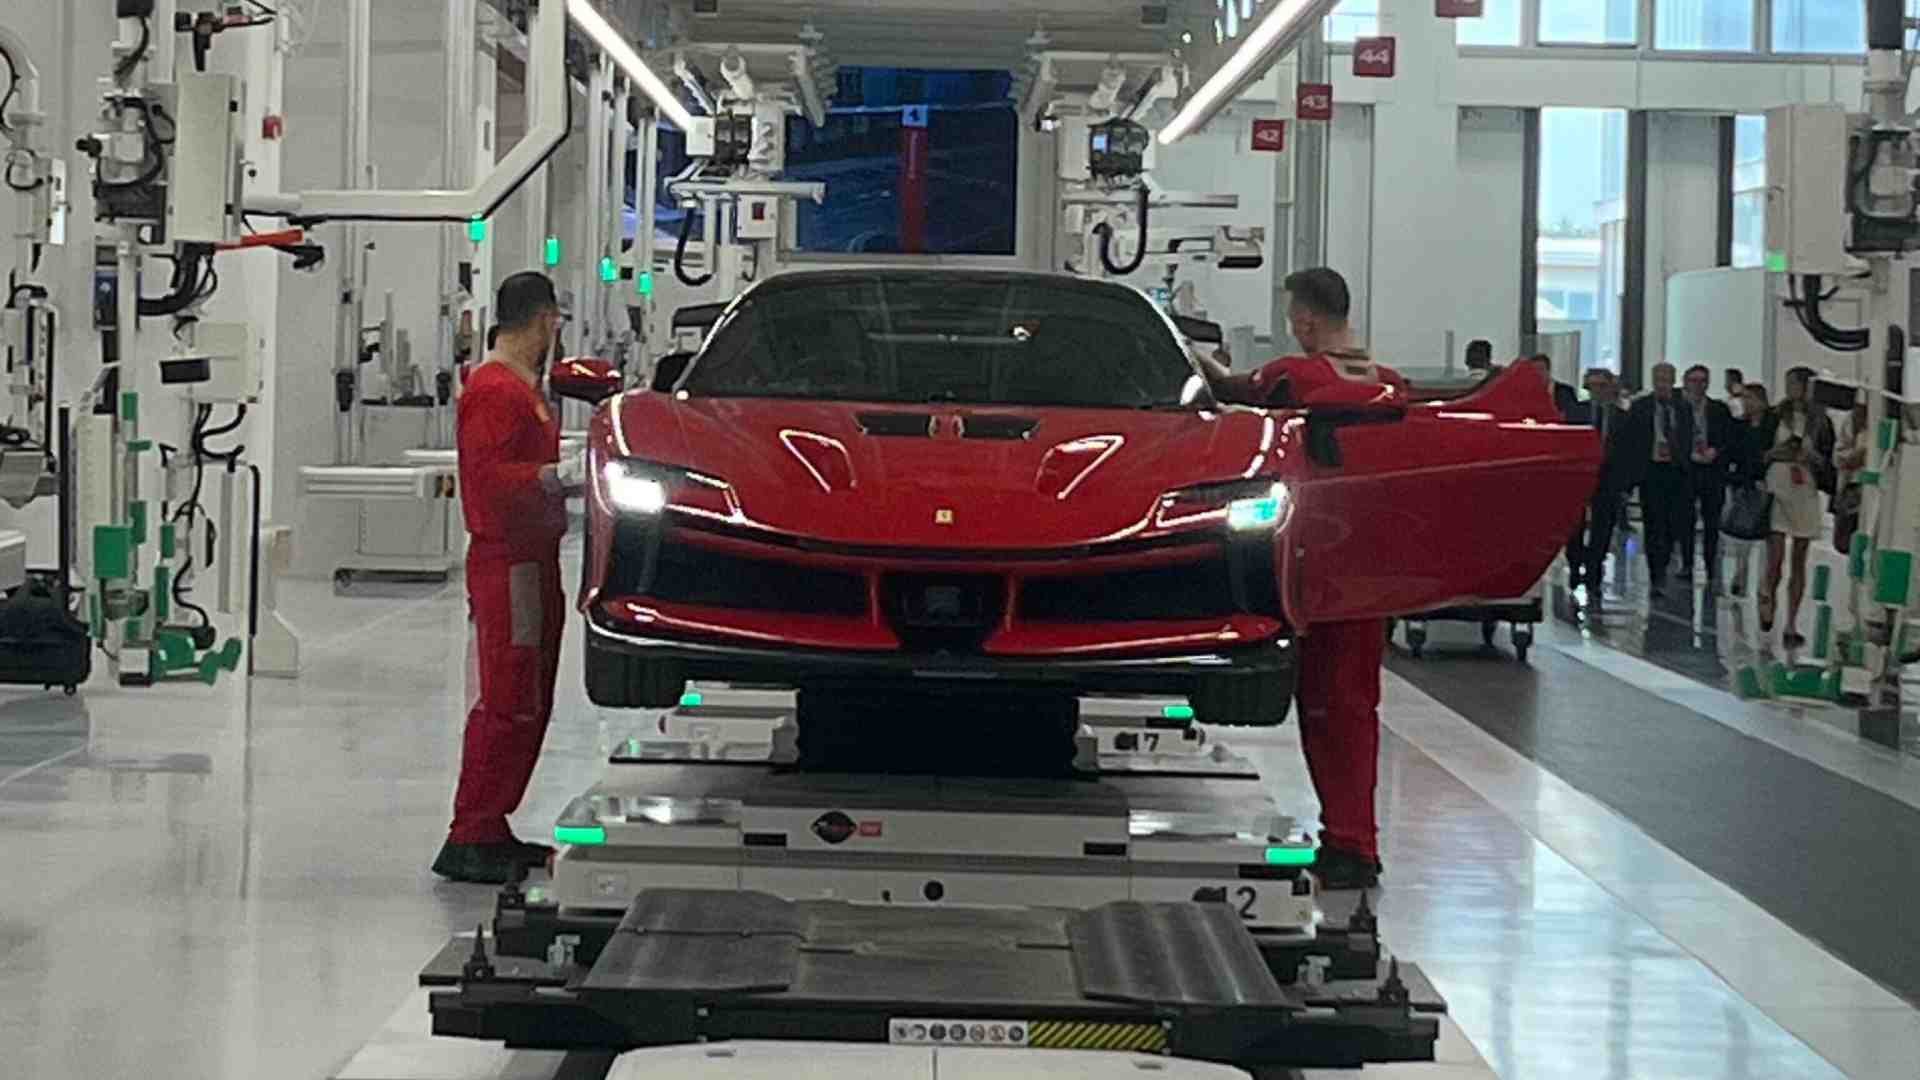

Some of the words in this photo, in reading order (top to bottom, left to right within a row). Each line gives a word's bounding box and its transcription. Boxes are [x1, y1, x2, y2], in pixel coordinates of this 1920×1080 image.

[1358, 48, 1390, 64] 44
[1301, 94, 1329, 110] 43
[1255, 128, 1281, 144] 42
[1143, 732, 1160, 752] 7
[1236, 885, 1257, 920] 2
